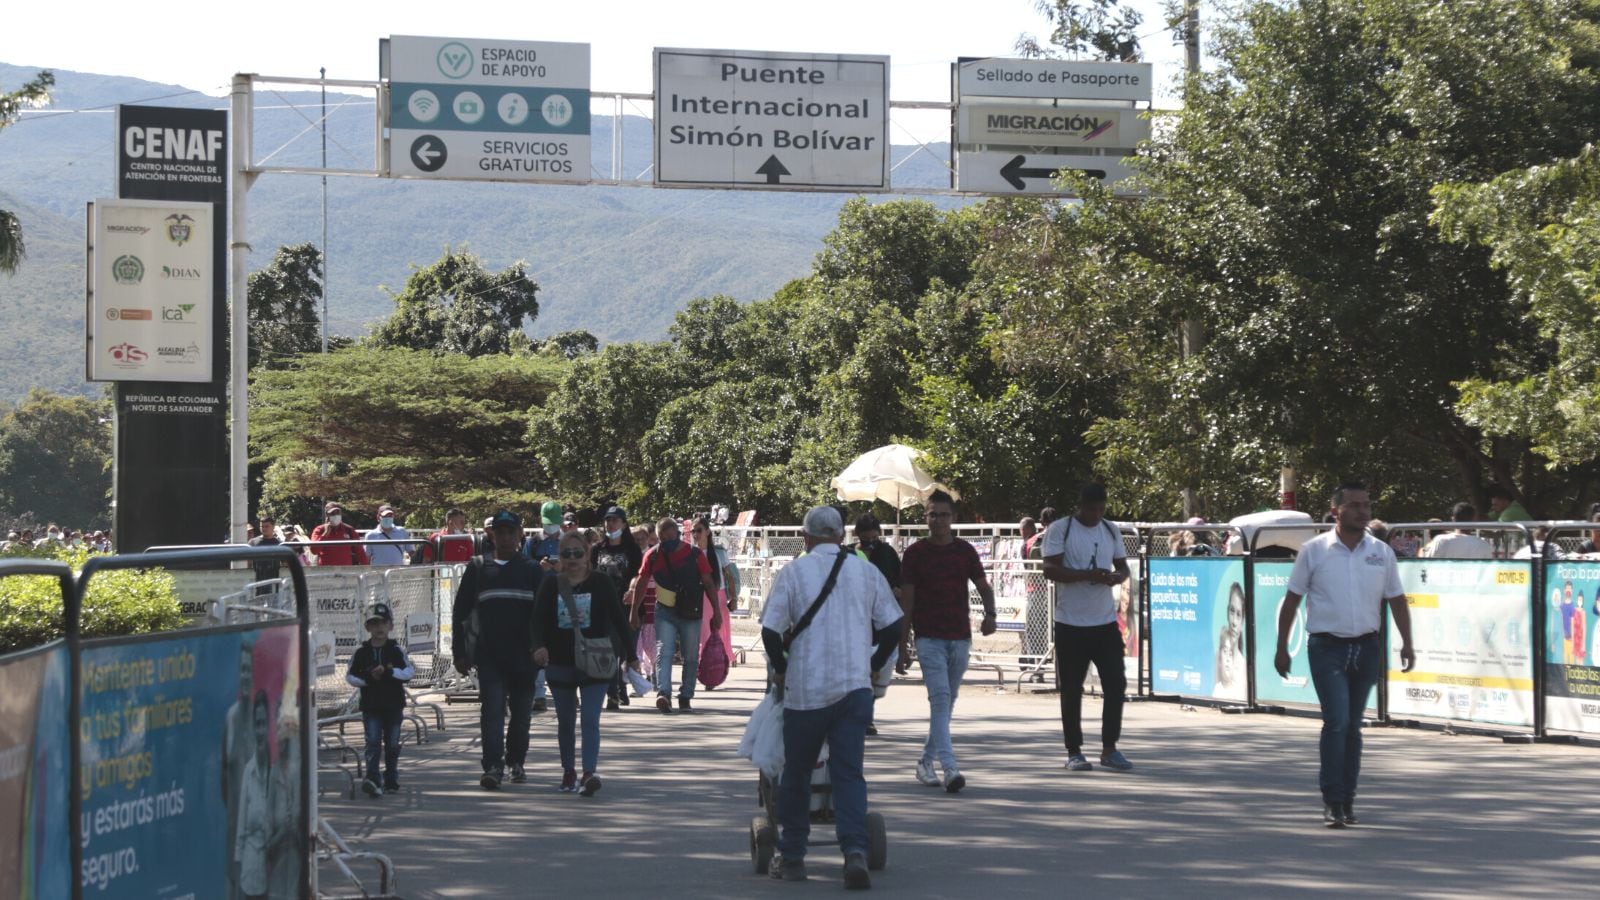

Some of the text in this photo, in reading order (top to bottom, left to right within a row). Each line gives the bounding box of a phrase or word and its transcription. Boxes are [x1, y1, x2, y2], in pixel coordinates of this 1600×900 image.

[482, 47, 537, 62] ESPACIO
[482, 63, 546, 78] DE APOYO
[721, 63, 825, 84] Puente
[976, 68, 1140, 87] Sellado de Pasaporte
[672, 94, 869, 119] Internacional
[987, 114, 1099, 131] MIGRACIÓN
[125, 126, 223, 161] CENAF
[669, 125, 875, 151] Simón Bolívar
[483, 140, 569, 156] SERVICIOS
[130, 162, 217, 174] CENTRO NACIONAL DE
[479, 157, 572, 173] GRATUITOS
[125, 171, 166, 180] ATENCIÓN
[179, 174, 222, 183] FRONTERAS
[172, 267, 201, 279] DIAN
[162, 306, 184, 321] ica
[125, 393, 219, 404] REPÚBLICA DE COLOMBIA
[132, 404, 156, 412] NORTE
[169, 405, 213, 413] SANTANDER
[1498, 572, 1525, 584] COVID-19
[160, 650, 196, 683] unido
[81, 696, 193, 743] a tus familiares
[81, 751, 153, 800] y amigos
[81, 780, 185, 849] y estarás más
[81, 847, 140, 891] seguro.
